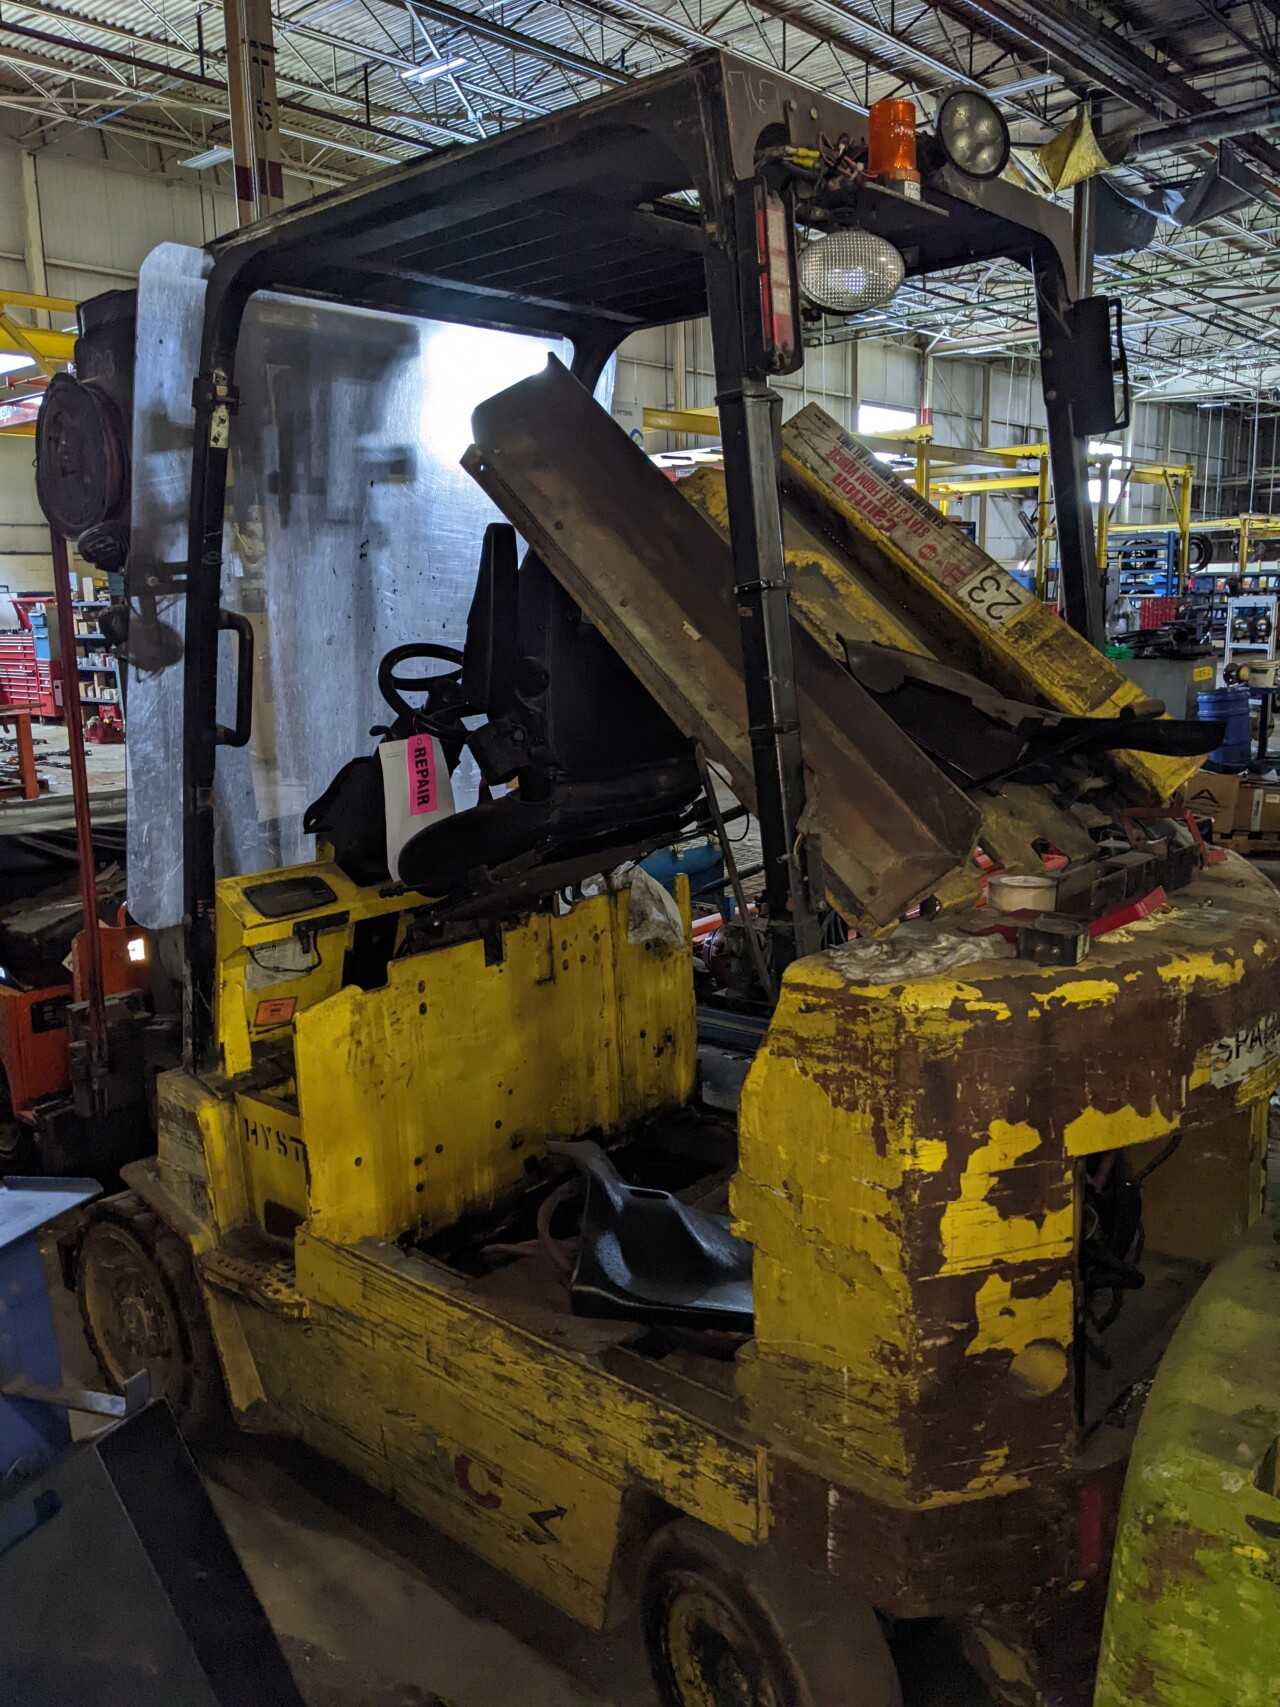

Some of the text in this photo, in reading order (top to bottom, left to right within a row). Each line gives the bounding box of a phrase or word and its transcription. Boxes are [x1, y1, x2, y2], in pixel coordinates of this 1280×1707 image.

[826, 445, 930, 540] STAY 3 FEET FROM VEHICLE
[831, 472, 897, 533] Caution
[968, 577, 1022, 619] 23
[414, 747, 430, 805] REPAIR
[243, 1117, 305, 1162] HYST
